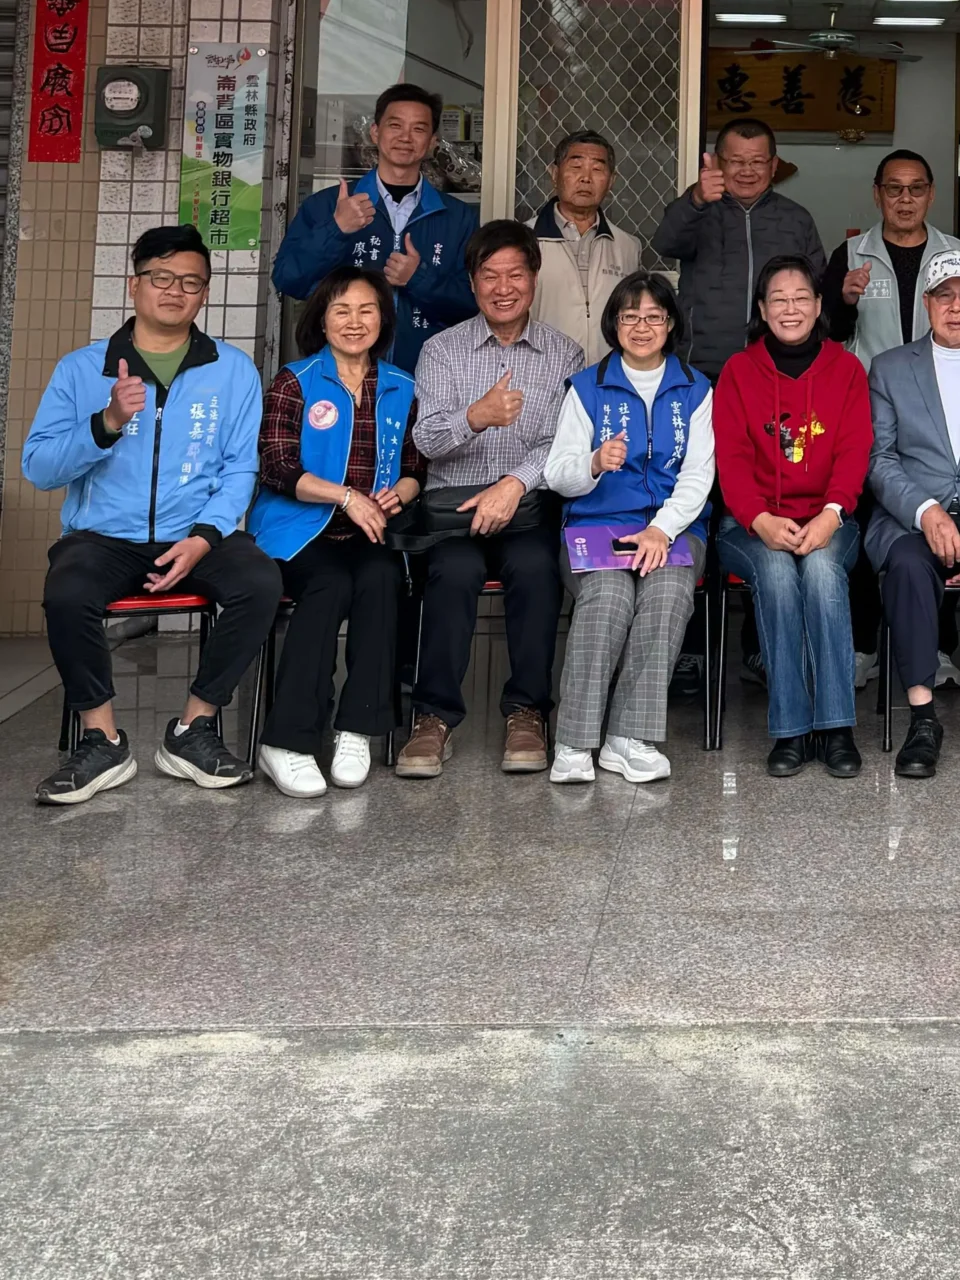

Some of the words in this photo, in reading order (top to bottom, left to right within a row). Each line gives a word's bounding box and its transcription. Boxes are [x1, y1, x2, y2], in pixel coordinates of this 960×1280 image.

[243, 74, 260, 147] 雲林縣政府
[209, 74, 237, 246] 崙背區實物銀行超市
[369, 235, 382, 261] 秘書
[186, 402, 207, 462] 張嘉郡
[205, 395, 220, 448] 立法委員
[664, 401, 687, 470] 雲林縣政府
